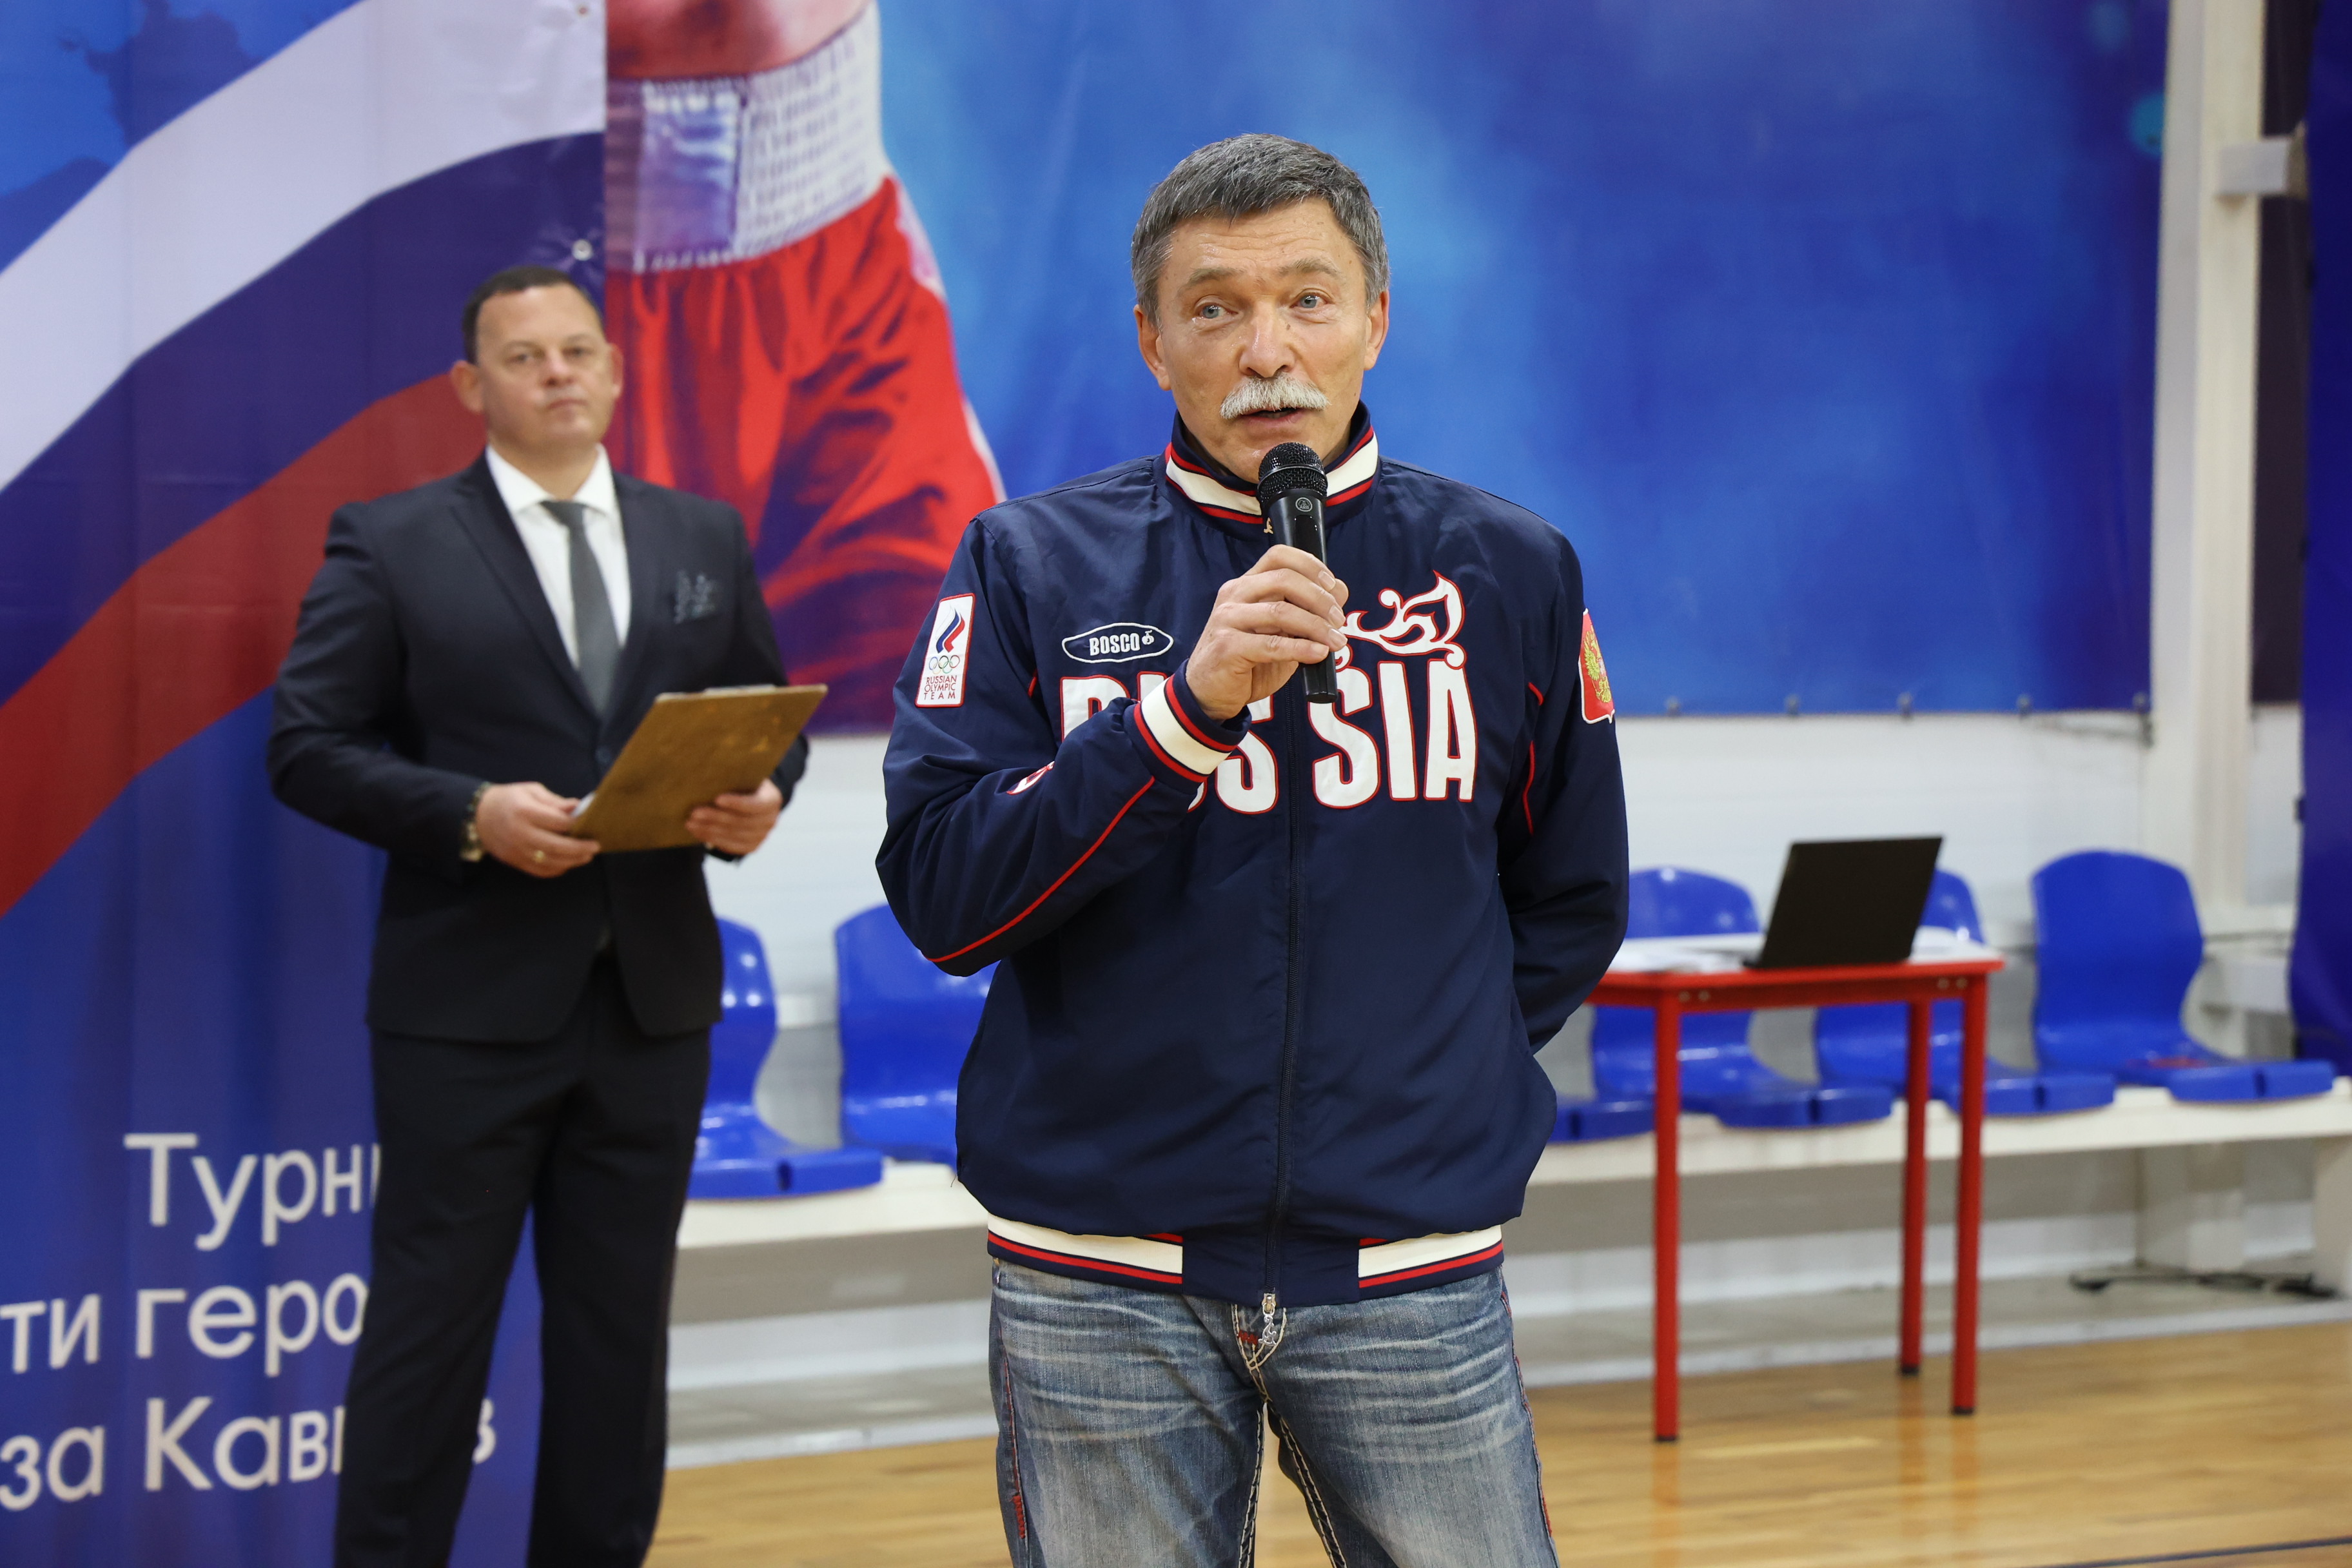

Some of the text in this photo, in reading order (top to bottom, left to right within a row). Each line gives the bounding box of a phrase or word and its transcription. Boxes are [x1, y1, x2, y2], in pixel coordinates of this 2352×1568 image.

[1090, 632, 1141, 656] BOSCO
[924, 682, 956, 692] OLYMPIC
[926, 675, 957, 684] RUSSIAN
[923, 691, 956, 700] TEAM
[124, 1133, 380, 1251] Турн
[0, 1426, 104, 1511] за
